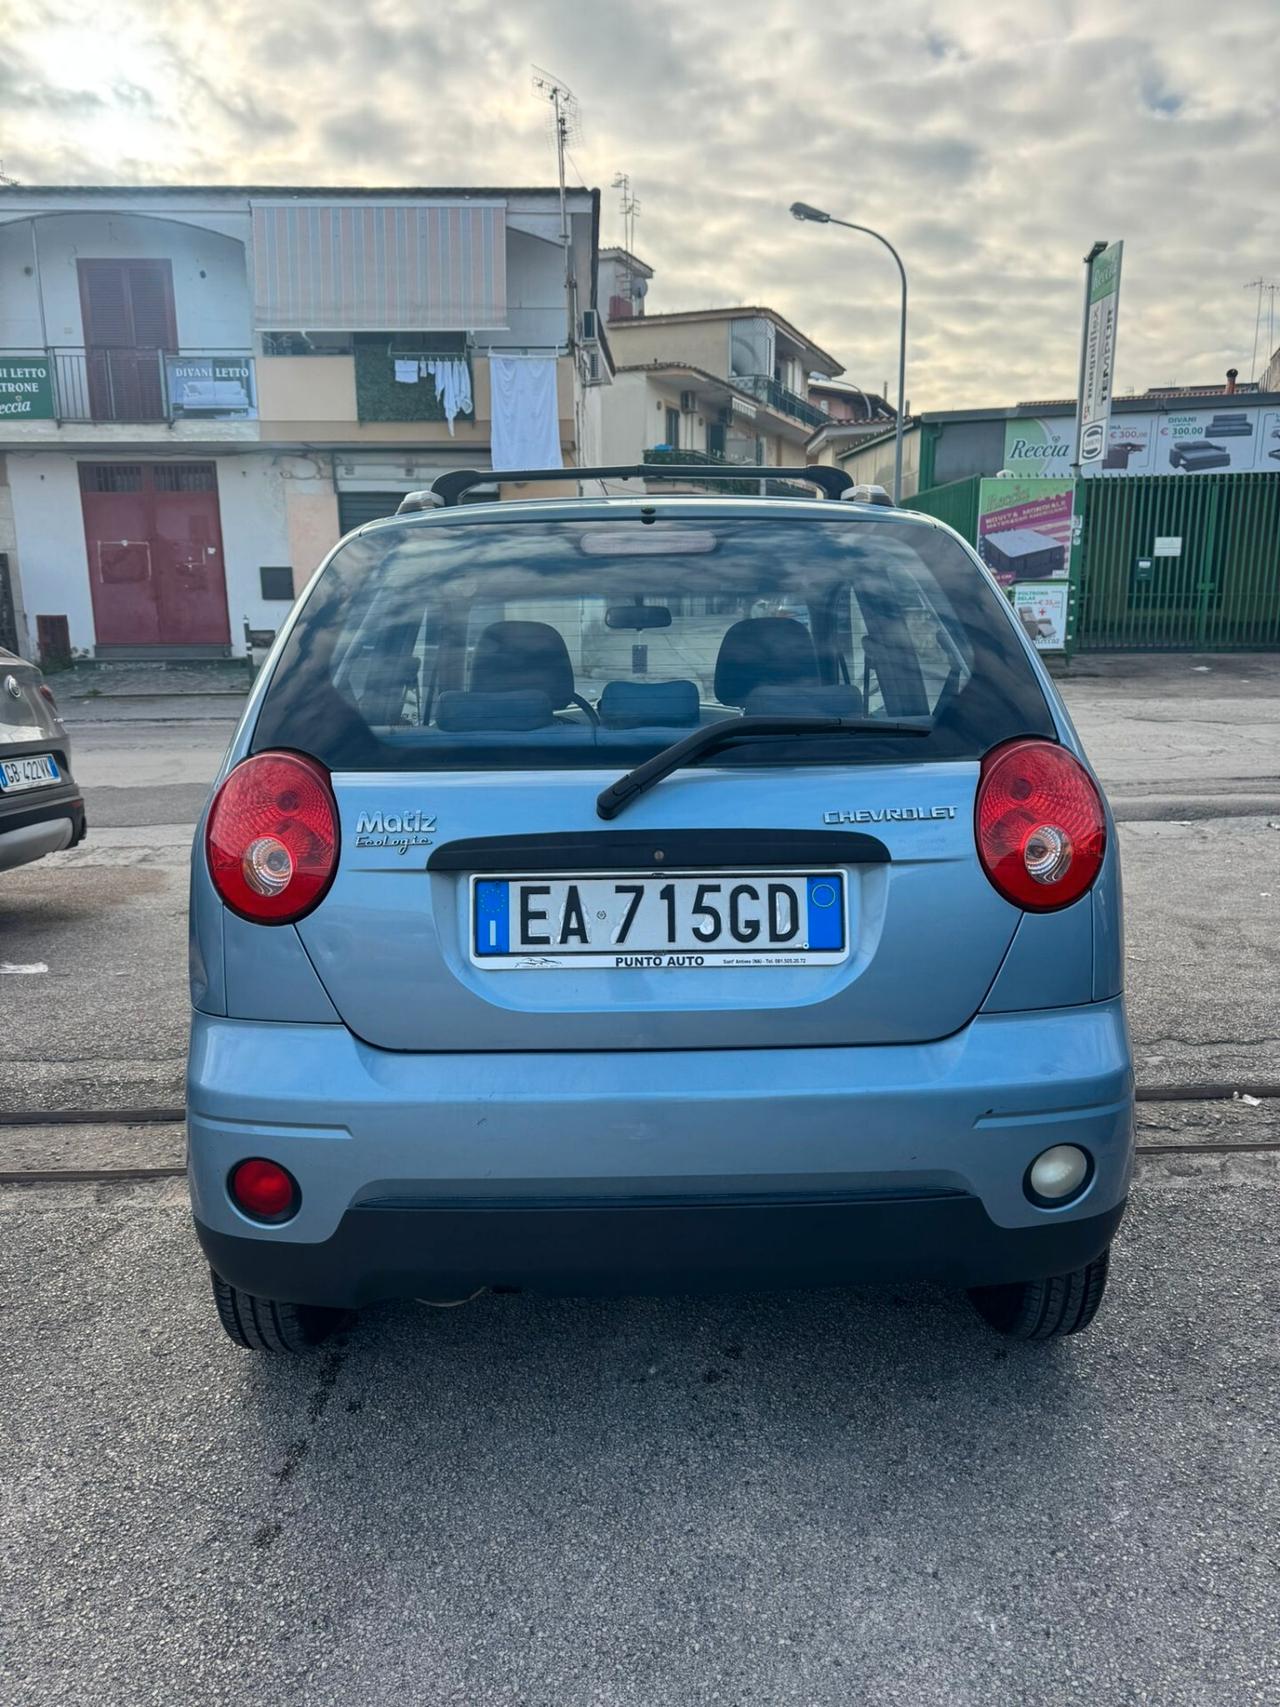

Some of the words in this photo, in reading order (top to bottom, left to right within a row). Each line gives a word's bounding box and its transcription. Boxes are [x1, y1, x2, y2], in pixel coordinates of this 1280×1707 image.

[10, 368, 46, 378] LETTO
[175, 368, 212, 377] DIVANI
[215, 368, 249, 377] LETTO
[0, 382, 39, 392] TRONE
[1010, 438, 1070, 459] Reccia
[356, 810, 437, 833] Matiz
[823, 805, 958, 825] CHEVROLET
[519, 885, 590, 946] EA
[614, 883, 800, 945] 715GD
[615, 956, 663, 967] PUNTO
[667, 956, 705, 967] AUTO
